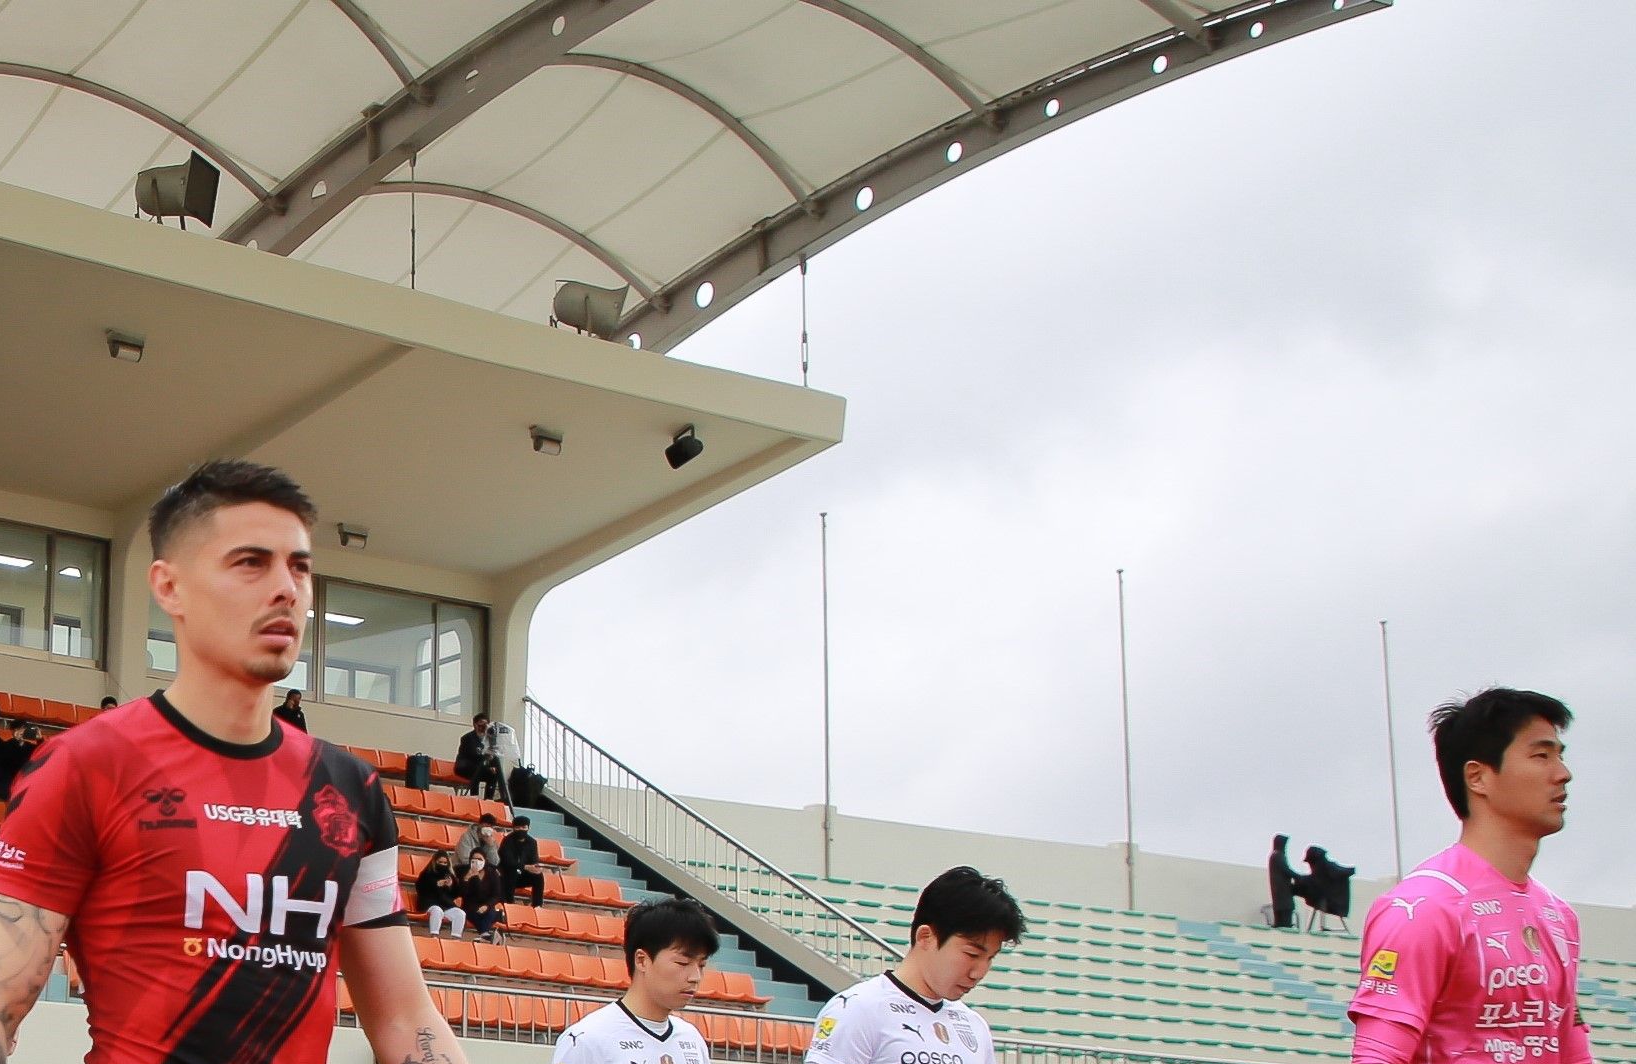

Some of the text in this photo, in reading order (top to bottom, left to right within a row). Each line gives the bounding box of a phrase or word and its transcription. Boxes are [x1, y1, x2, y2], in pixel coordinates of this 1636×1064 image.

[204, 803, 302, 829] USG공유대학
[183, 869, 339, 939] NH
[207, 937, 327, 971] NongHyup
